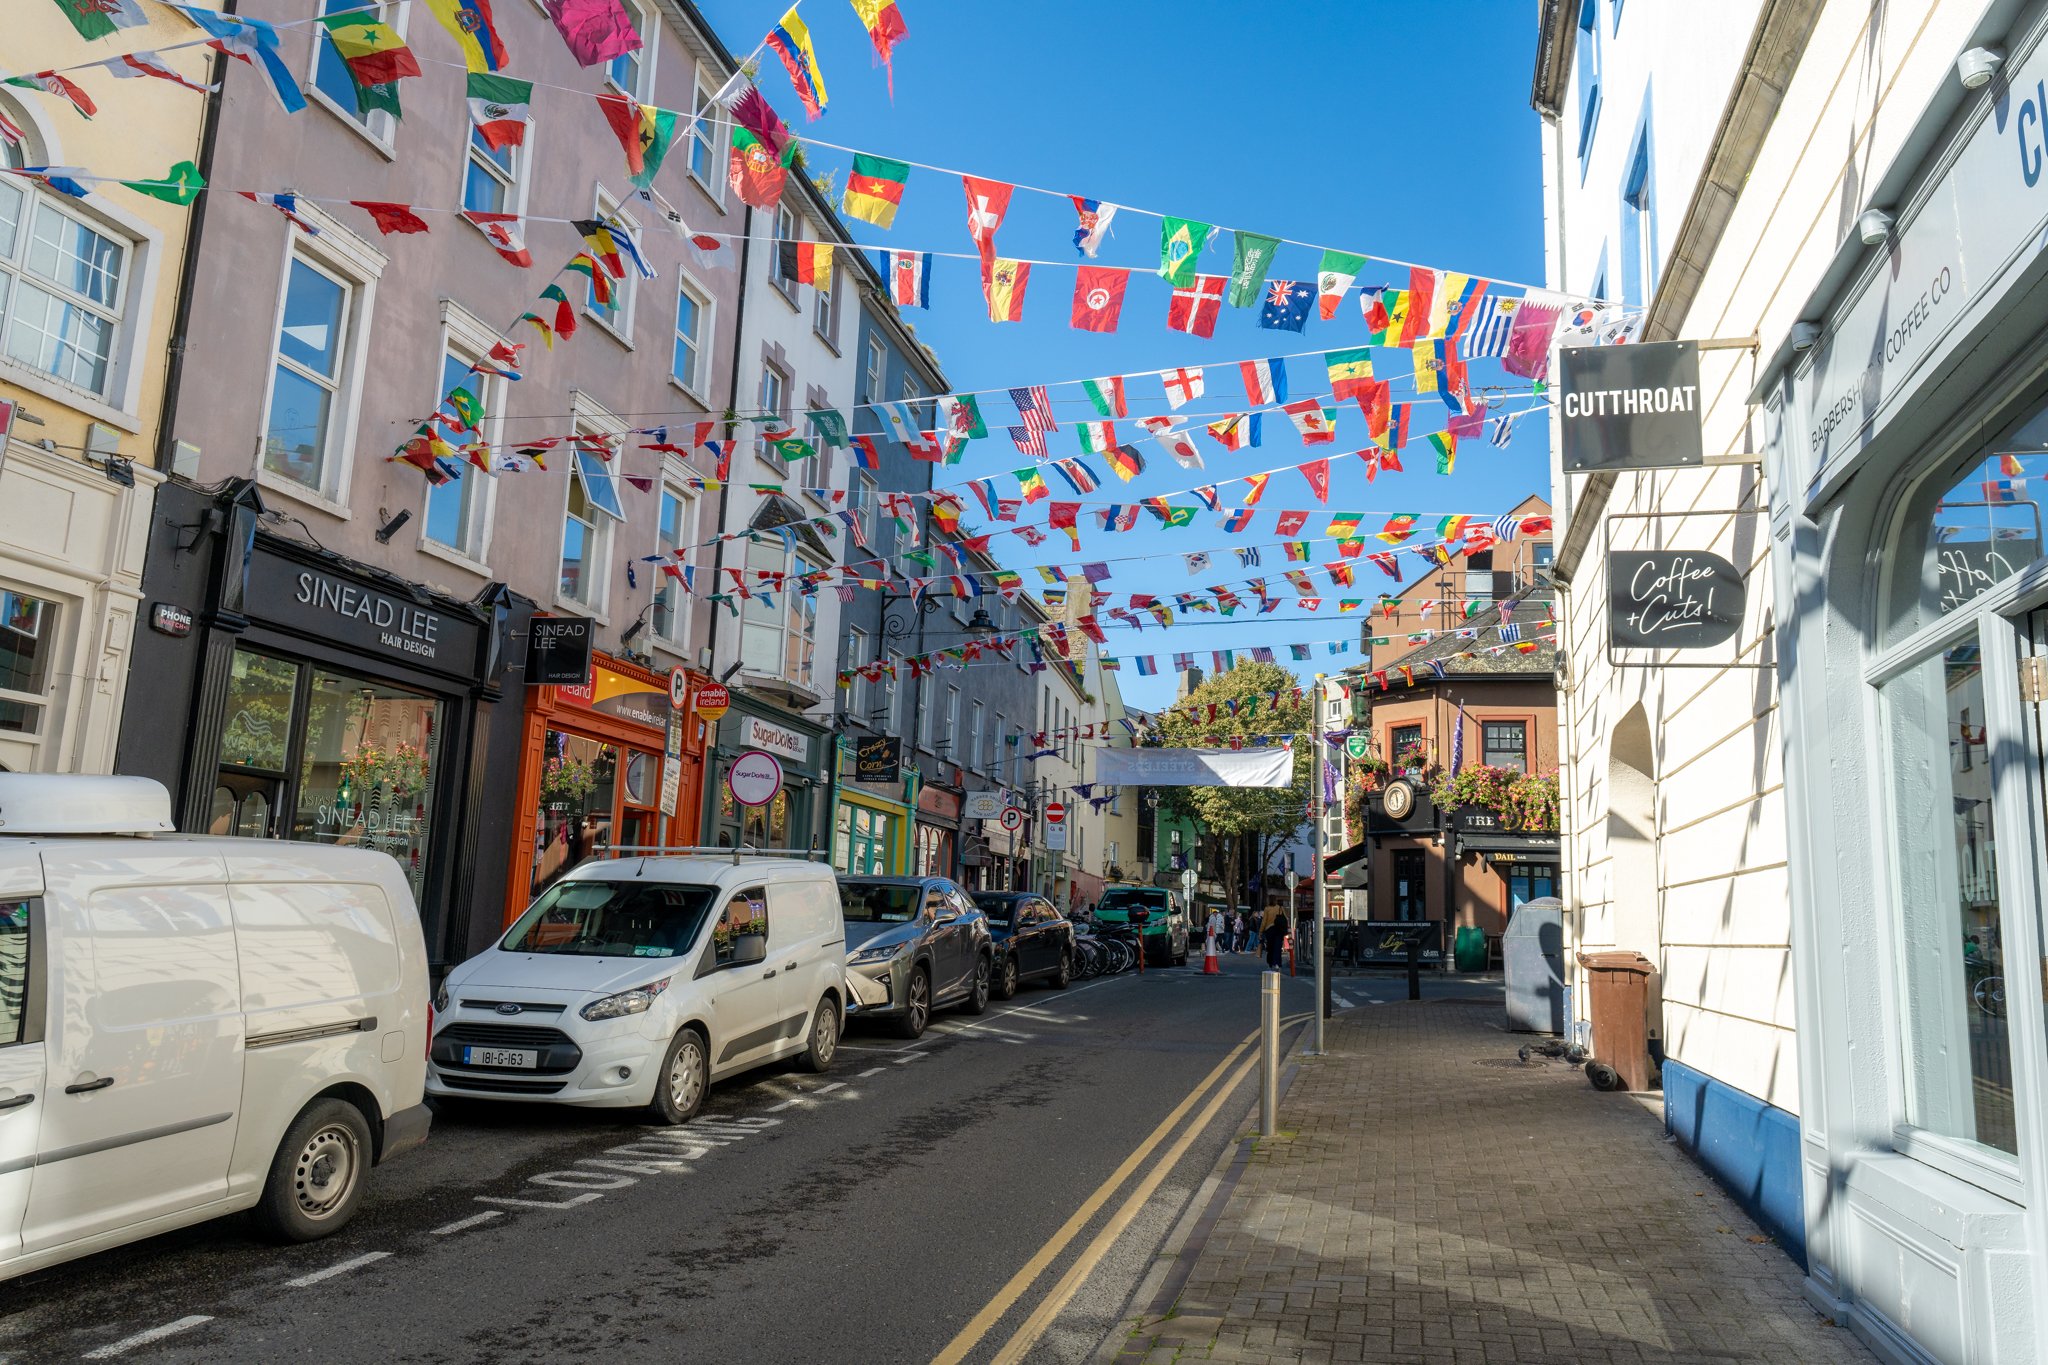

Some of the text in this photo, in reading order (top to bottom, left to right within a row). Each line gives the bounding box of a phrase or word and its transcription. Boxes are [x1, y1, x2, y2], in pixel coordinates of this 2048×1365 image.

[1811, 362, 1874, 453] BARBERSHOP
[1885, 291, 1930, 363] COFFEE
[1931, 266, 1951, 305] CO
[1565, 386, 1697, 418] CUTTHROAT
[1631, 557, 1715, 602] Coffee
[296, 572, 439, 643] SINEAD LEE
[160, 609, 191, 625] PHONE
[535, 624, 585, 636] SINEAD
[381, 632, 435, 658] HAIR DESIGN
[534, 637, 557, 649] LEE
[675, 673, 682, 698] P
[700, 689, 726, 697] enable
[700, 697, 726, 706] ireland
[317, 805, 381, 829] SINEAD
[1007, 812, 1016, 825] P
[1465, 815, 1495, 826] THE
[371, 836, 409, 846] HAIR DESIGN
[1494, 852, 1516, 861] DAIL
[482, 1051, 523, 1066] 181-G-163
[473, 1114, 784, 1209] LOADING
